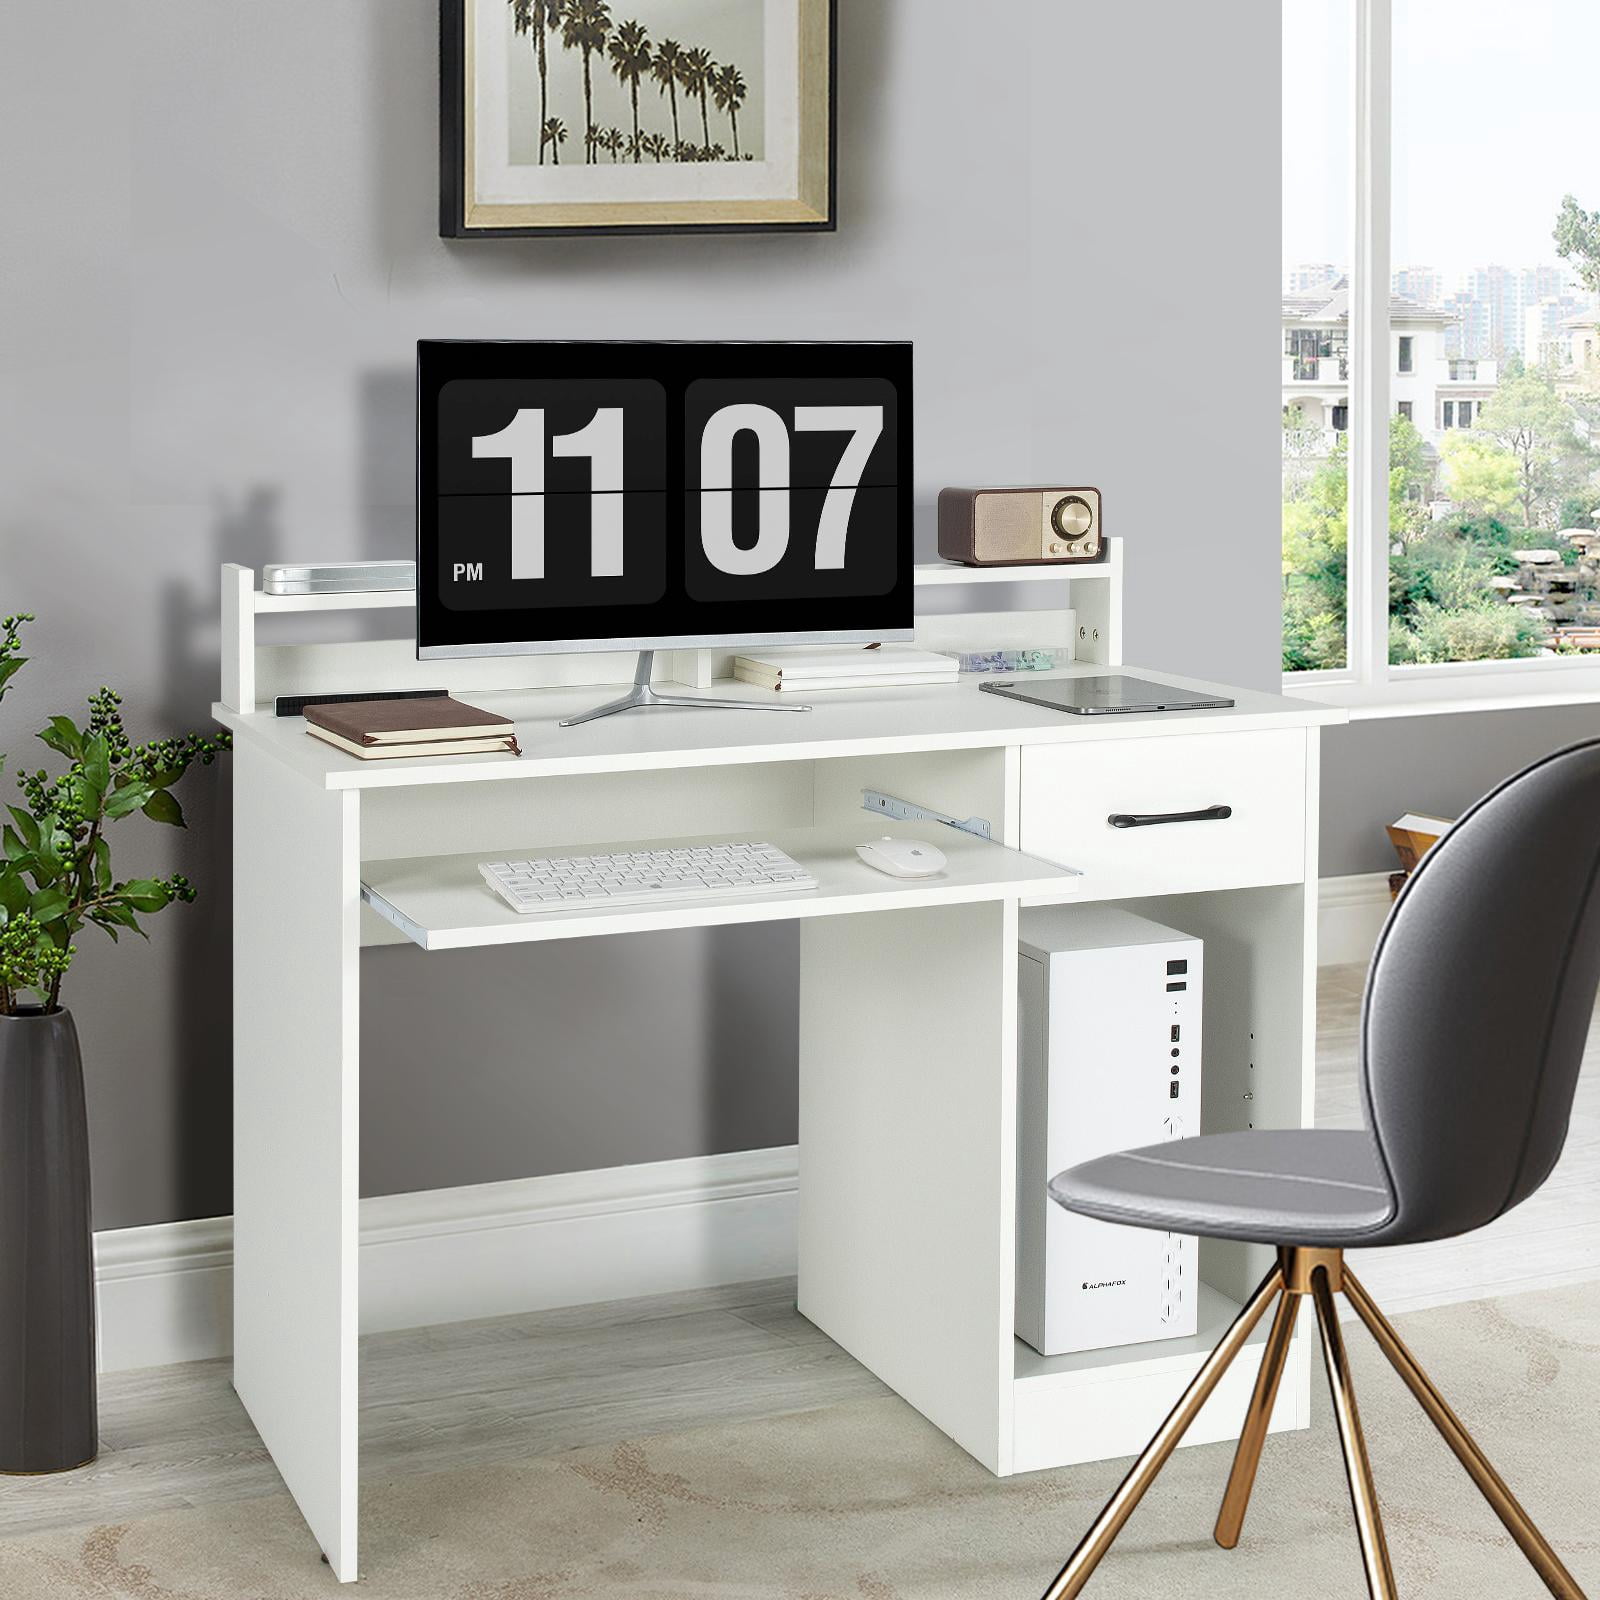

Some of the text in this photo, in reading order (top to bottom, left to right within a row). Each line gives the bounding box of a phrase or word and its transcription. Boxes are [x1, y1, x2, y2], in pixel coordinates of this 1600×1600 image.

[472, 404, 884, 579] 11 07
[453, 562, 483, 582] PM
[1089, 1279, 1127, 1290] ALPHAFOX
